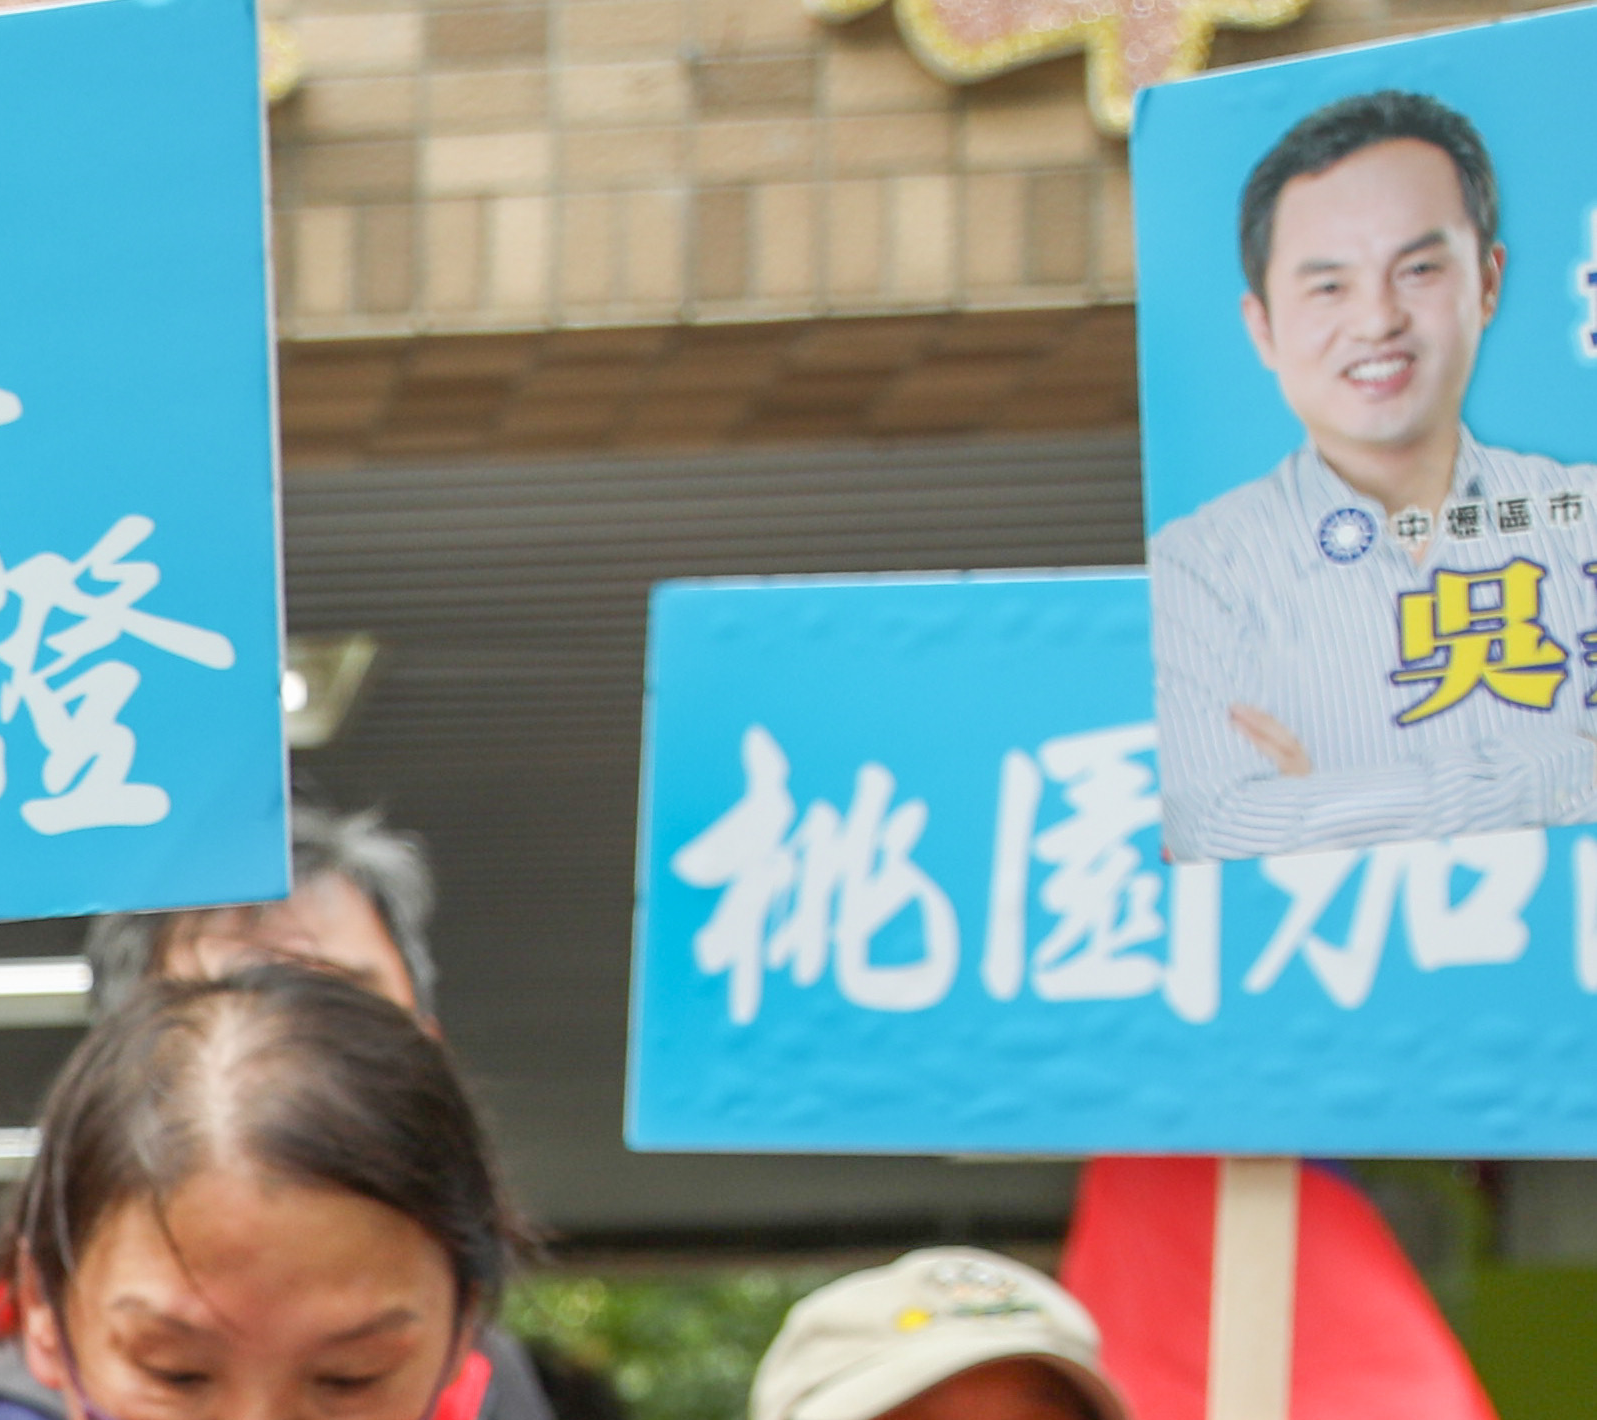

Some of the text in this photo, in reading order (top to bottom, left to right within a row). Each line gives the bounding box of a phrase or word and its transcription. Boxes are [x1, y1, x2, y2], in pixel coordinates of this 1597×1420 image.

[1390, 556, 1597, 728] 吳
[671, 722, 1597, 1024] 桃園加
